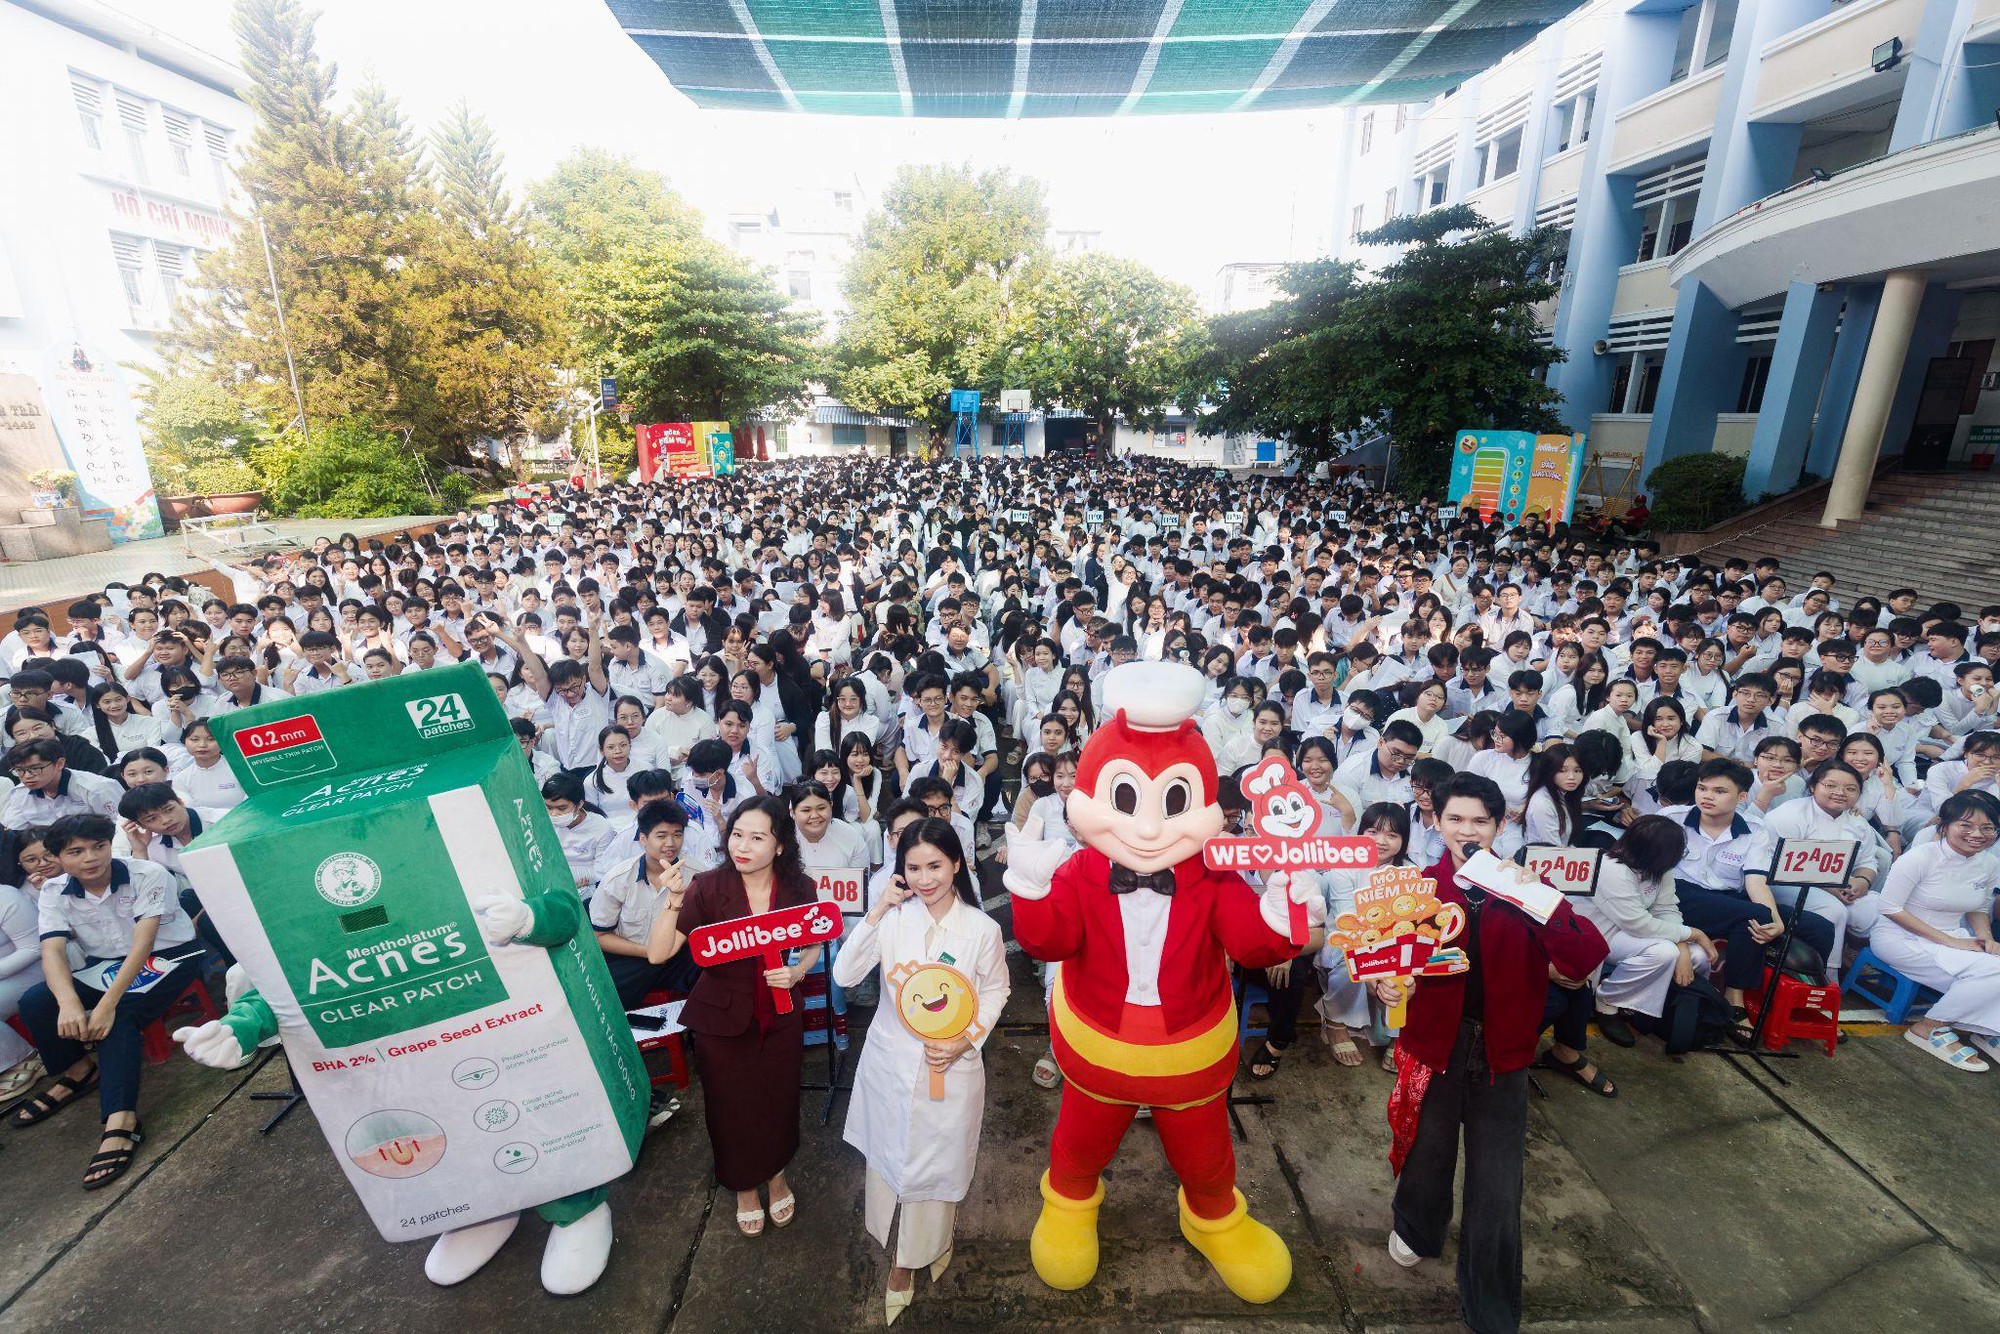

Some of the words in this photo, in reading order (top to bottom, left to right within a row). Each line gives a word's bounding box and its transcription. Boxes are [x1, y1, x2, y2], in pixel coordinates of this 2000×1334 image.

[416, 695, 460, 726] 24
[250, 730, 280, 748] 0.2
[280, 729, 306, 743] mm
[424, 720, 471, 738] patches
[251, 753, 283, 766] INVISIBLE
[284, 751, 301, 761] THIN
[300, 744, 324, 756] PATCH
[299, 767, 425, 802] Acnes
[281, 797, 346, 818] CLEAR
[350, 781, 414, 802] PATCH
[1210, 845, 1250, 865] WE
[1272, 839, 1369, 865] Jollibee
[1784, 848, 1846, 873] 12A05
[1399, 870, 1418, 880] RA
[1529, 856, 1590, 882] 12A06
[814, 876, 858, 902] A08
[1405, 882, 1434, 895] VUI
[701, 923, 802, 958] Jollibee
[309, 931, 467, 995] Acnes
[1360, 958, 1389, 968] Jollibee
[320, 996, 399, 1023] CLEAR
[402, 970, 483, 1004] PATCH
[312, 1060, 347, 1072] BHA
[349, 1055, 376, 1068] 2%
[388, 1038, 437, 1057] Grape
[440, 1023, 482, 1043] Seed
[485, 1003, 543, 1030] Extract
[400, 1217, 416, 1228] 24
[420, 1203, 470, 1225] patches
